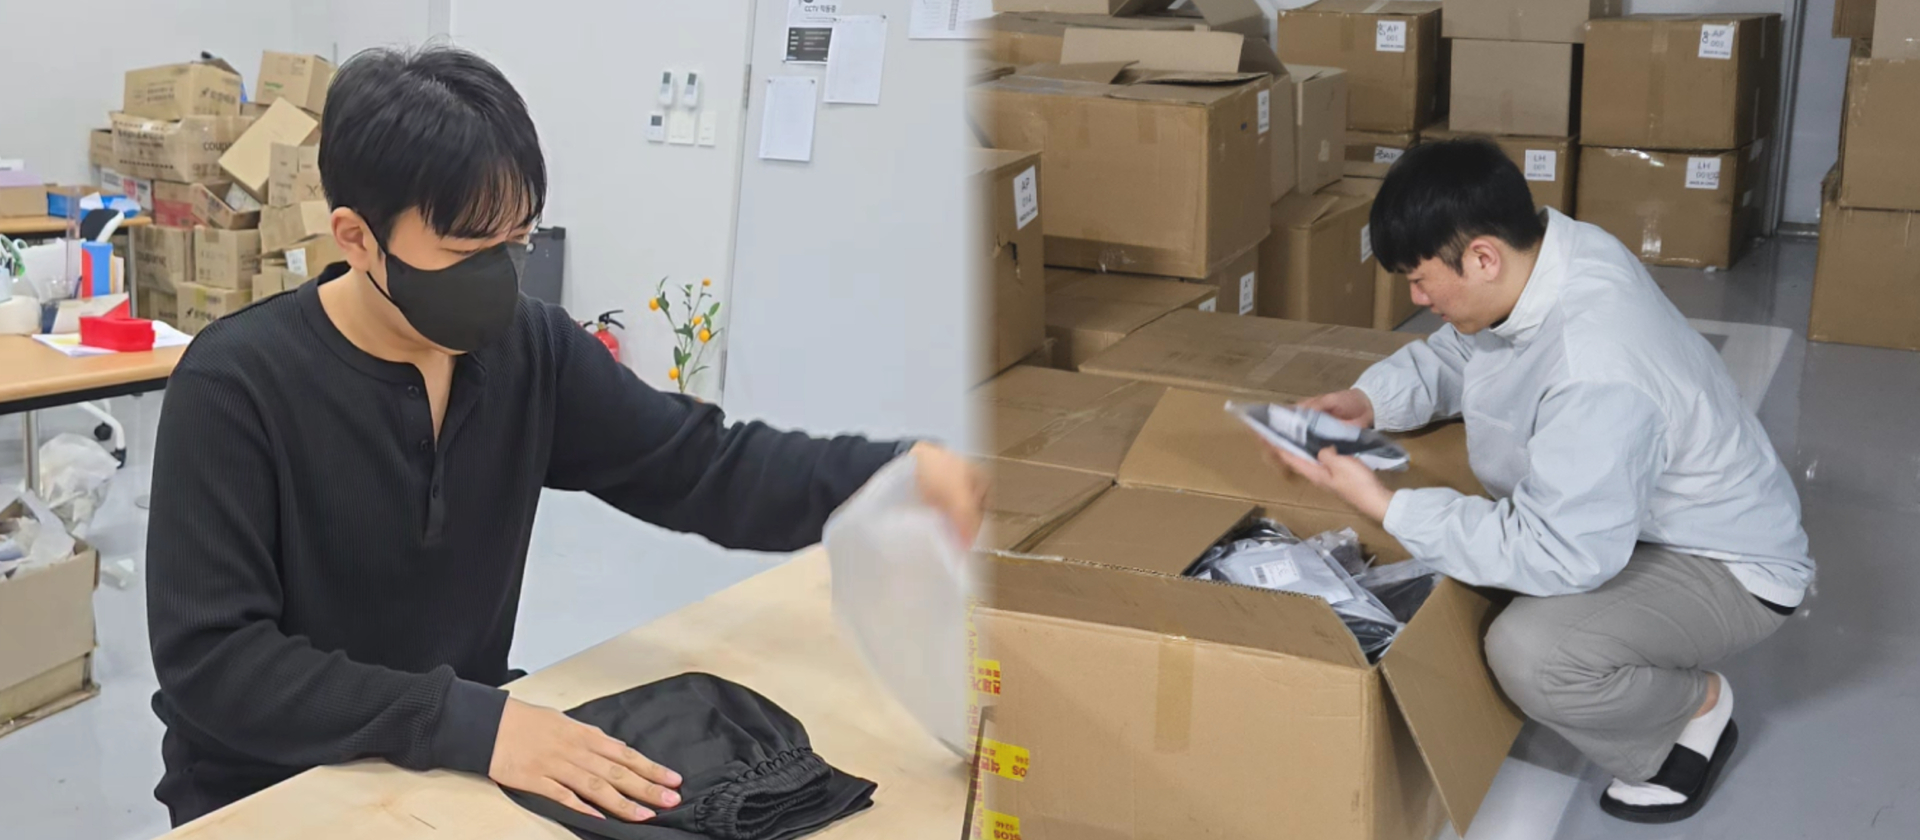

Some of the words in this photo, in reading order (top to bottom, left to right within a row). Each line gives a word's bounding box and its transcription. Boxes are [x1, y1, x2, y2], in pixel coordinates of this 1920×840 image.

[1386, 24, 1399, 33] AP
[1711, 29, 1726, 37] AP
[1533, 154, 1546, 162] LH
[1697, 161, 1711, 169] LH
